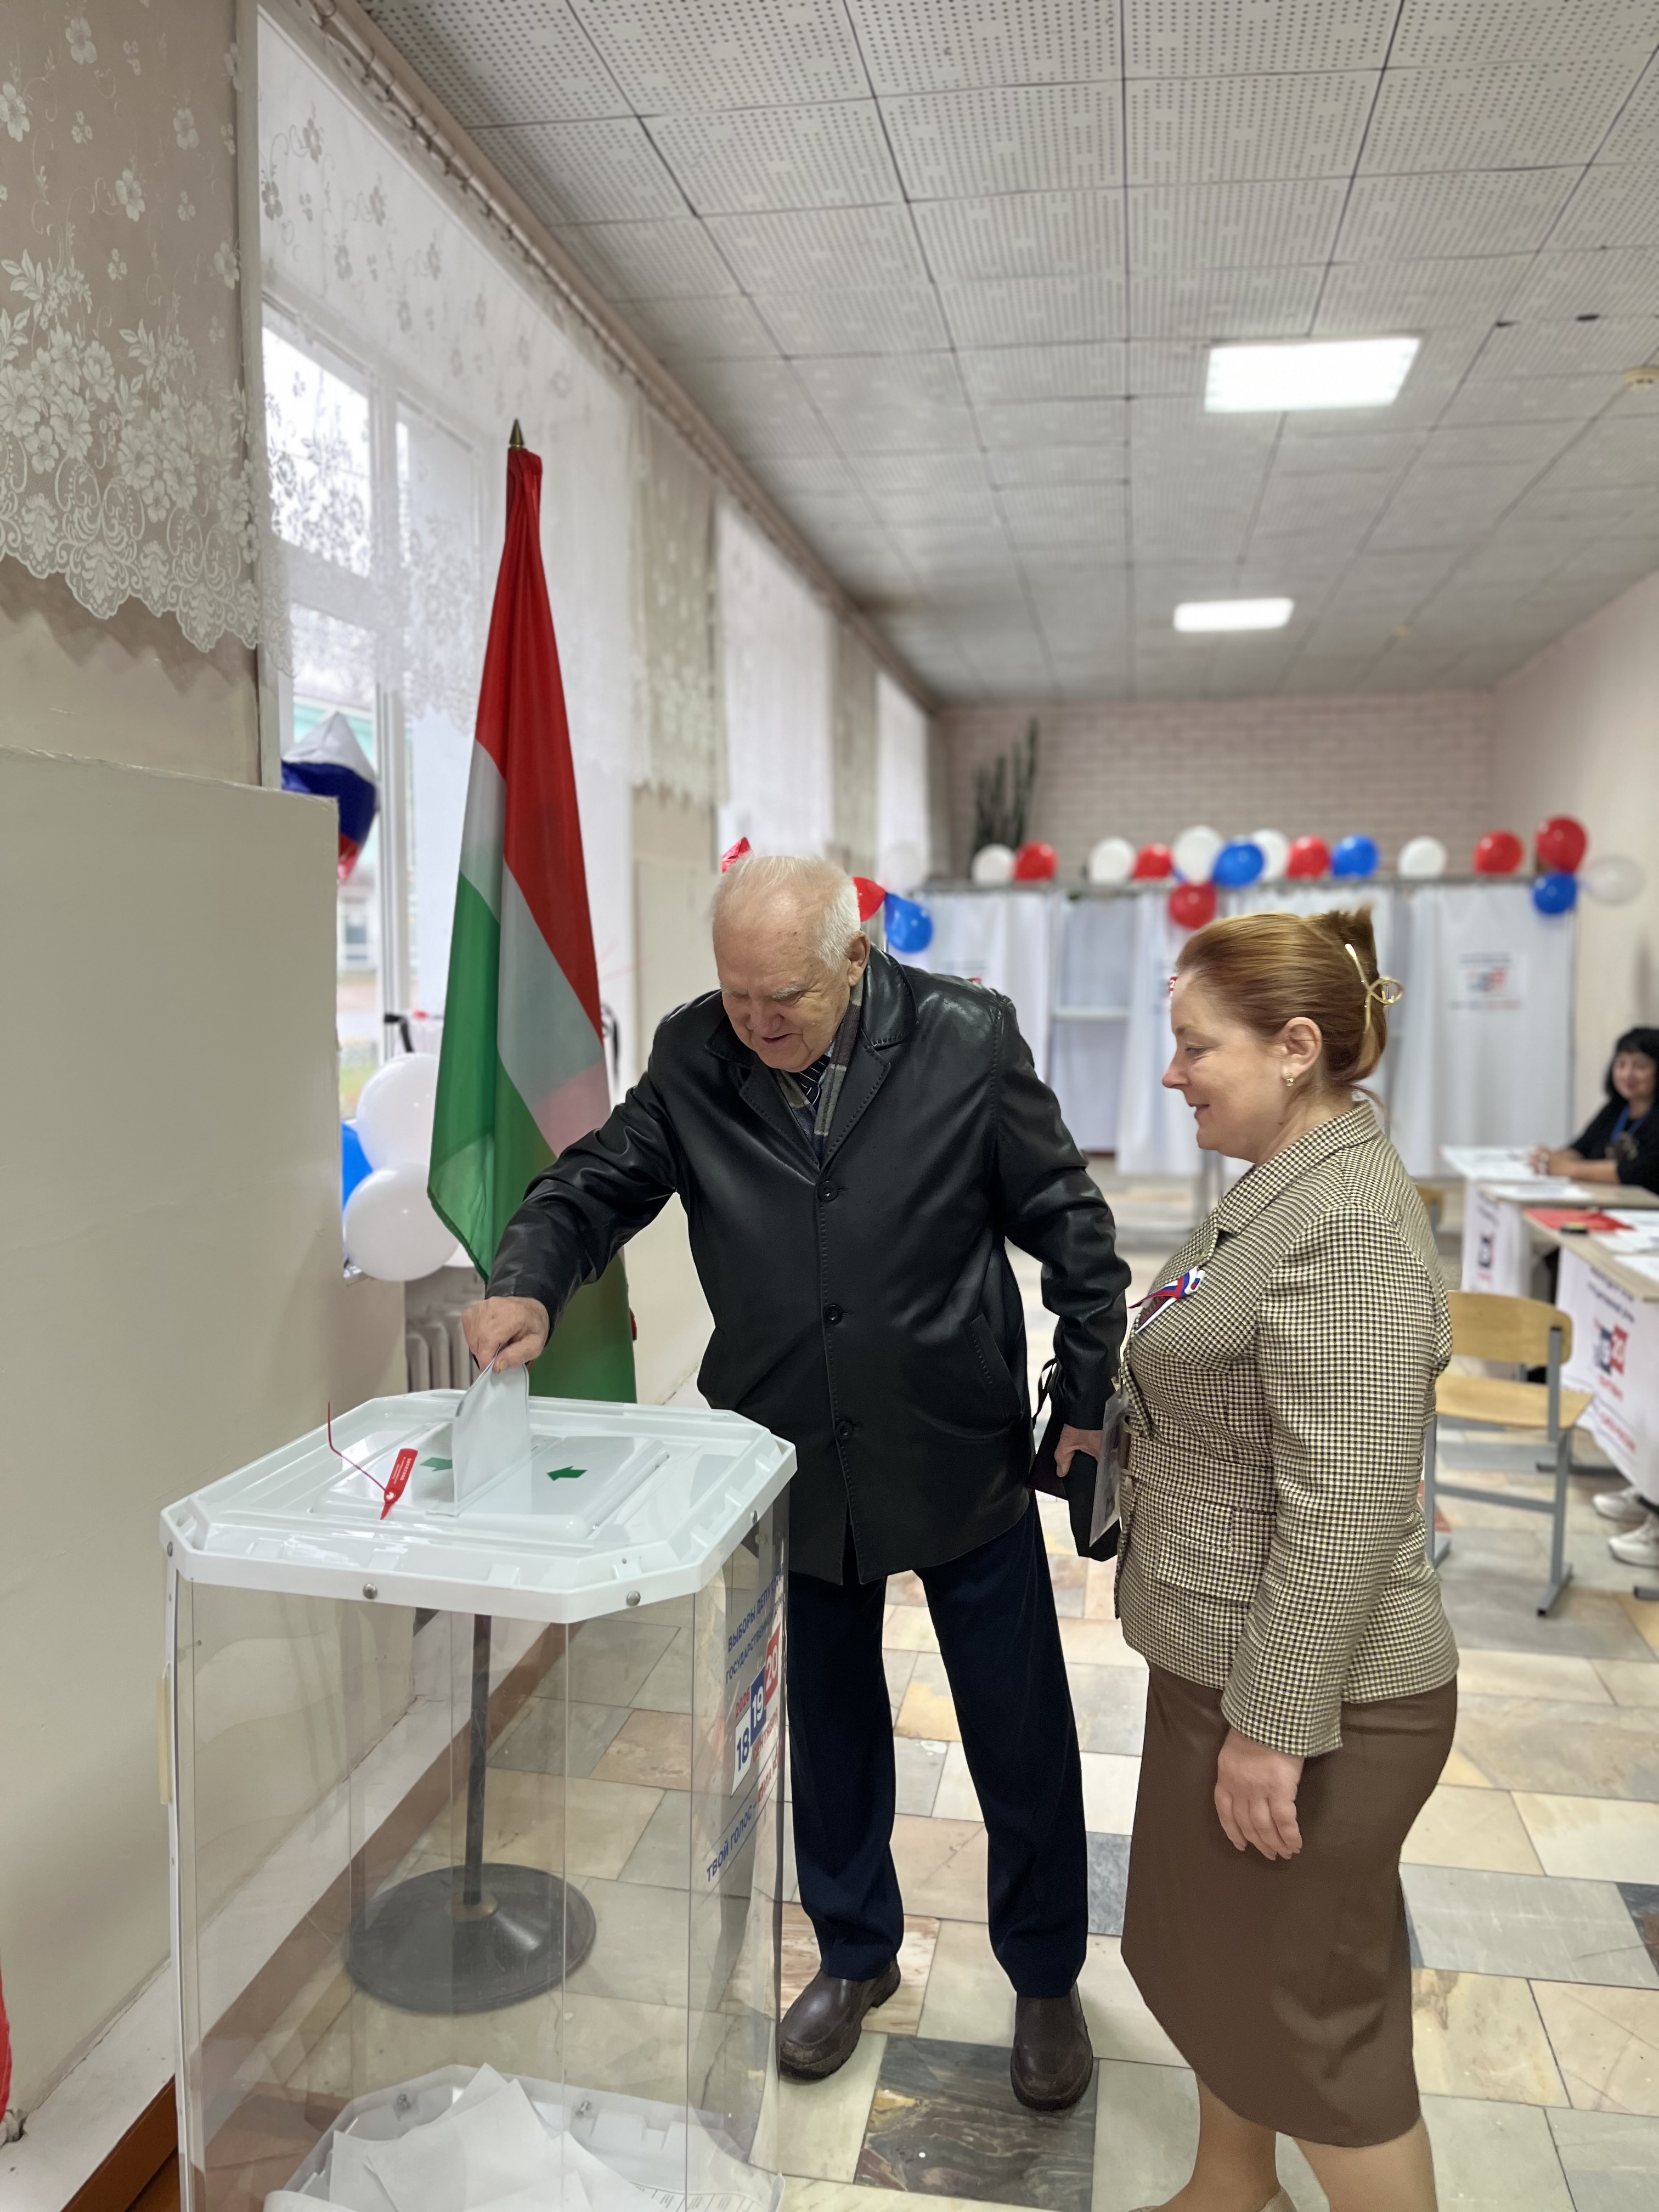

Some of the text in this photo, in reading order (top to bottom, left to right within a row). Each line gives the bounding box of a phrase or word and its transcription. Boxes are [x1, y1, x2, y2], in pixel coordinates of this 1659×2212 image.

[728, 1605, 755, 1654] ВЫБОРЫ
[766, 1645, 778, 1691] 20
[735, 1686, 750, 1718] 2026
[752, 1685, 764, 1728] 19
[737, 1727, 749, 1772] 18
[707, 1838, 729, 1882] ТВОЙ
[730, 1804, 752, 1850] ГОЛОС
